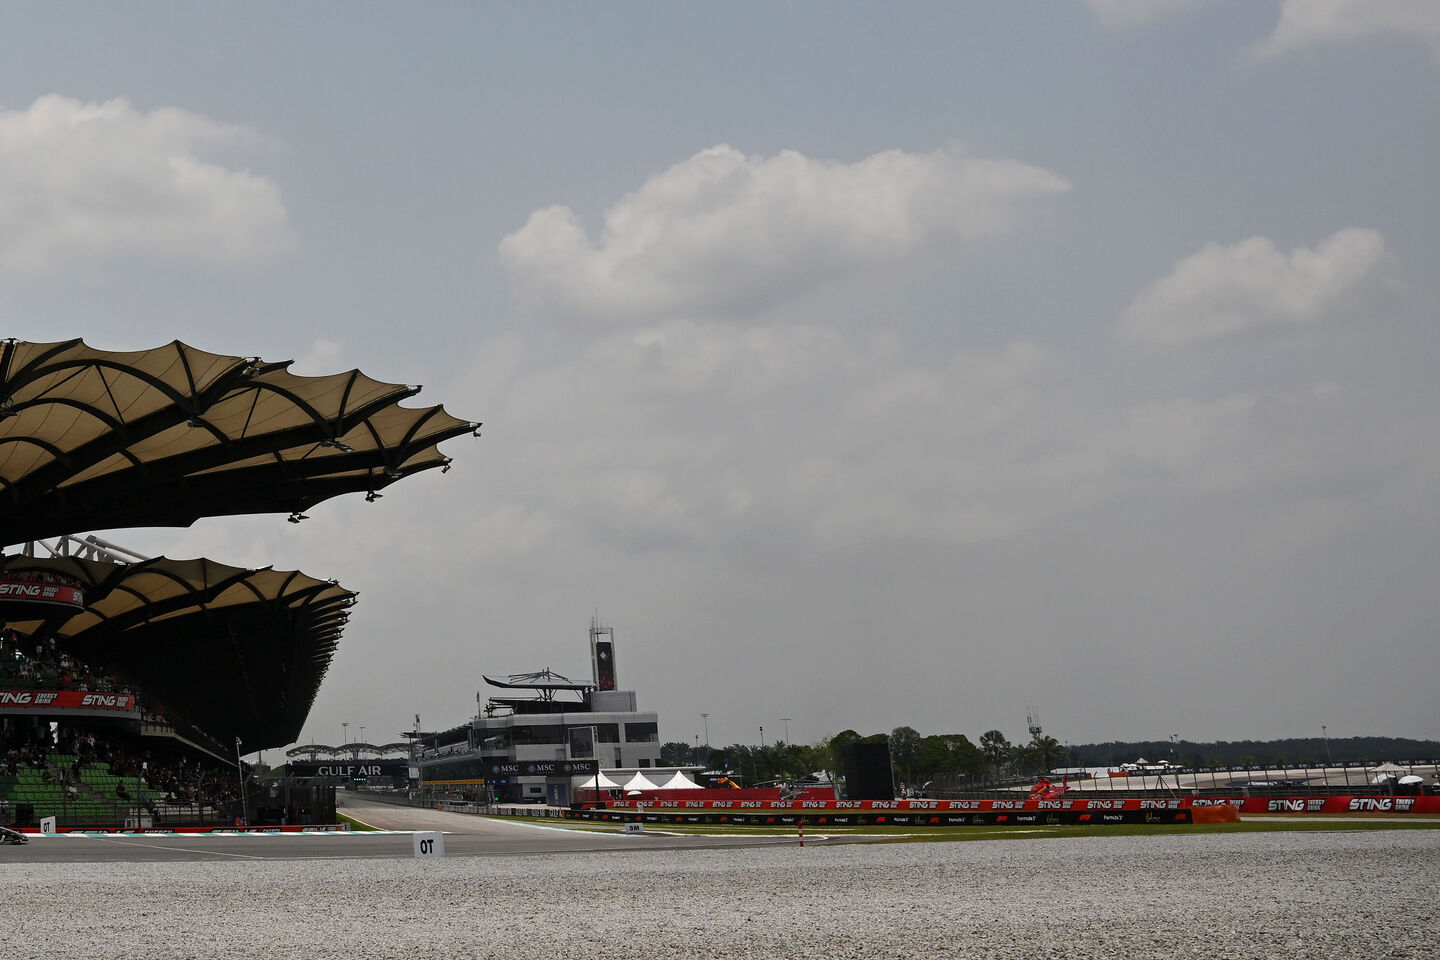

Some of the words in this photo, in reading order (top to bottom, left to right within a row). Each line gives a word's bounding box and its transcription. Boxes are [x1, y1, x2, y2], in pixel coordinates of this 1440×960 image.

[81, 694, 116, 706] STING
[318, 766, 355, 776] GULF
[358, 765, 381, 775] AIR
[1087, 800, 1112, 809] STING
[1140, 800, 1166, 809] STING
[1268, 800, 1305, 811] STING
[1349, 799, 1392, 811] STING
[43, 822, 50, 832] OT
[420, 839, 434, 854] OT
